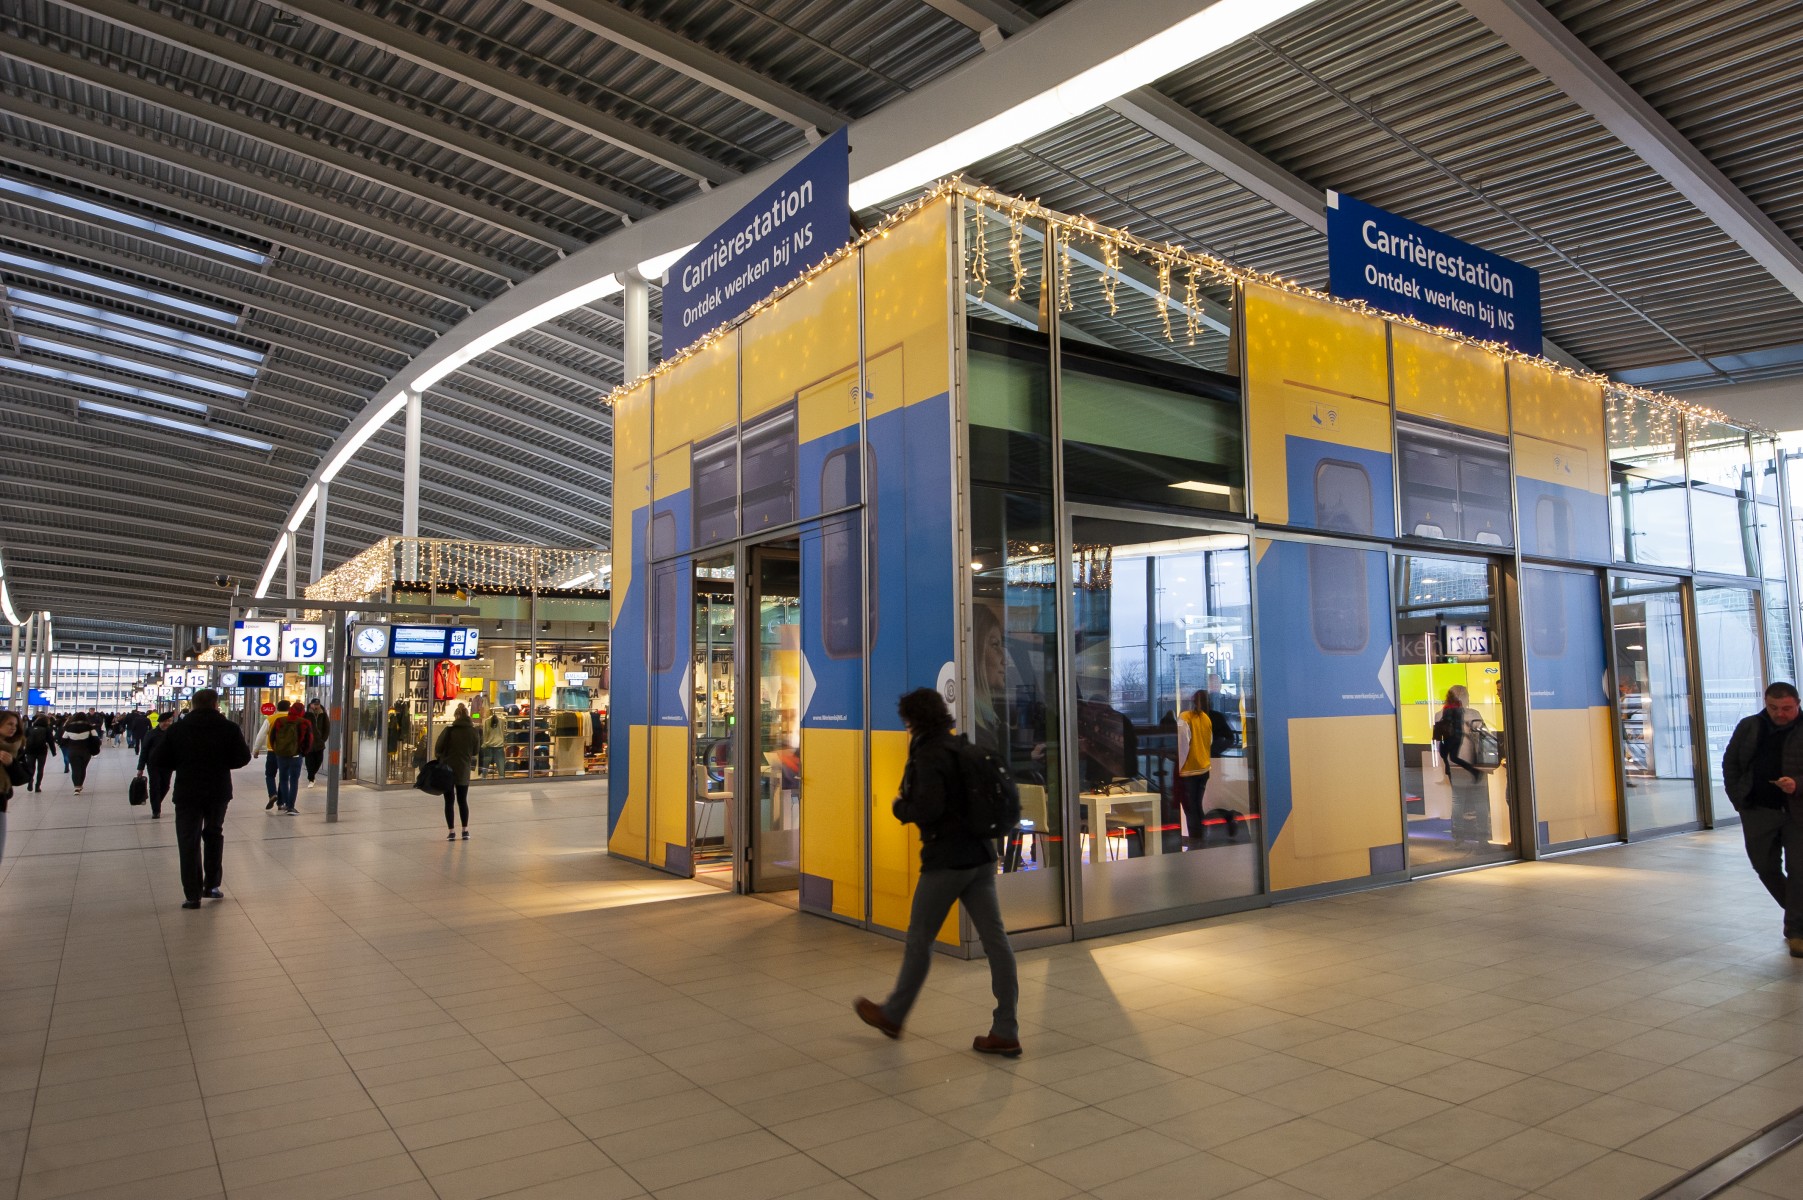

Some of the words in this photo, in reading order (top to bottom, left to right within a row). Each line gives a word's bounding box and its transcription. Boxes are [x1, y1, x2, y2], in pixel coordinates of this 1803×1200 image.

[682, 179, 813, 293] Carrièrestation
[683, 286, 722, 328] Ontdek
[724, 257, 770, 300] werken
[773, 236, 790, 267] bij
[794, 222, 813, 254] NS
[1361, 219, 1514, 299] Carrièrestation
[1364, 264, 1421, 300] Ontdek
[1424, 287, 1475, 318] werken
[1478, 301, 1495, 329] bij
[1497, 308, 1515, 331] NS
[241, 635, 271, 657] 18
[289, 637, 318, 658] 19
[168, 675, 183, 685] 14
[191, 675, 205, 686] 15
